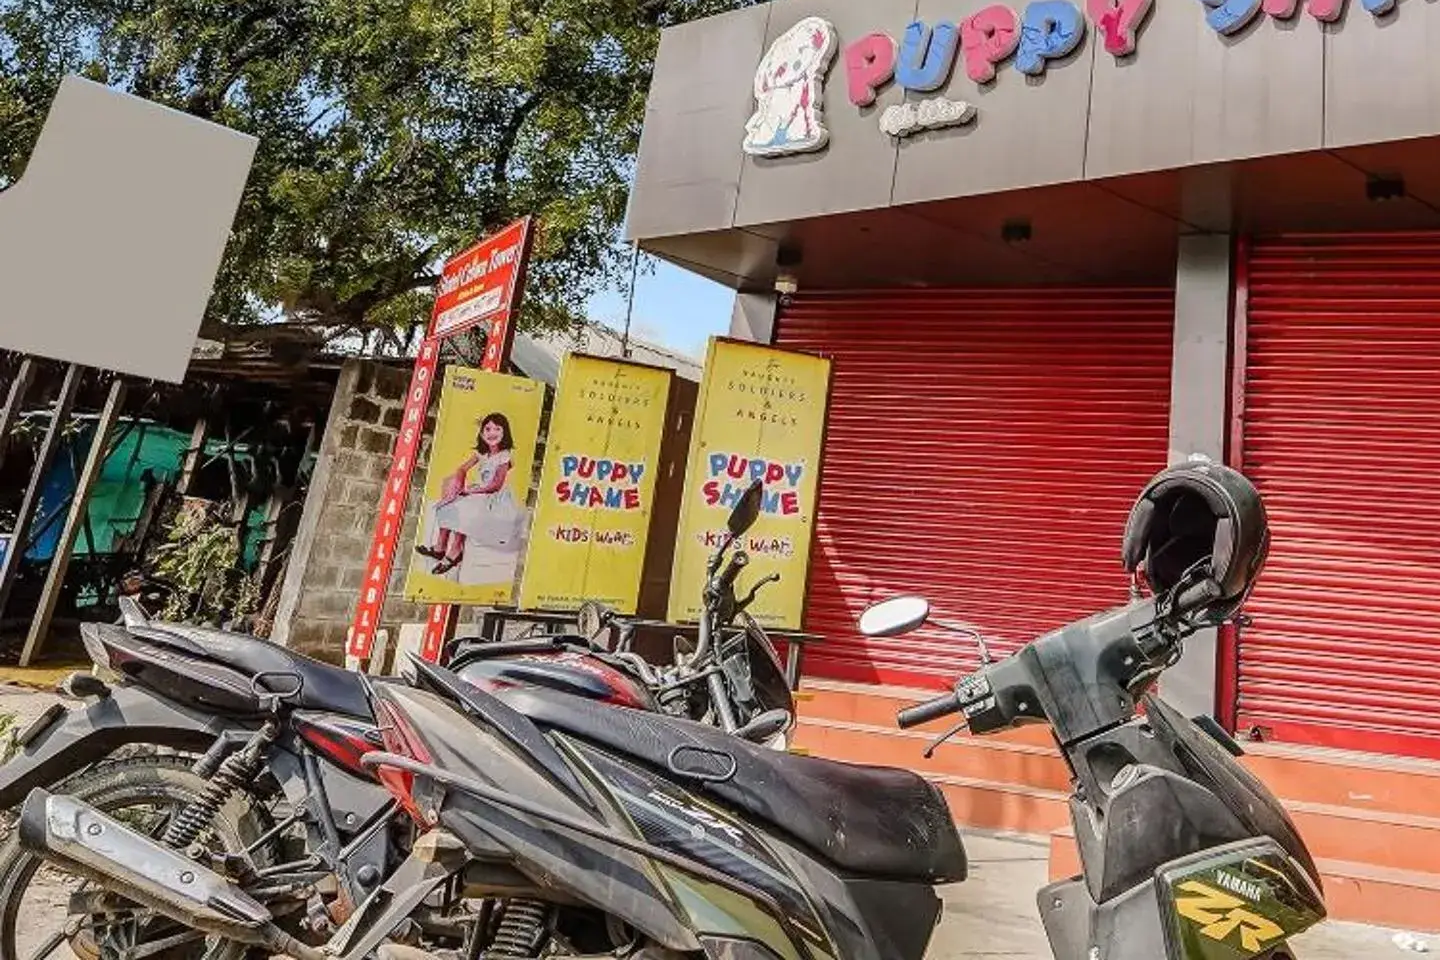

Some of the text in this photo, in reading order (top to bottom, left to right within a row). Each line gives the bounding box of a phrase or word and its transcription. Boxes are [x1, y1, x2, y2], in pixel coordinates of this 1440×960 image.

[562, 456, 644, 484] PUPPY
[709, 453, 802, 486] PUPPY
[356, 346, 433, 650] ROOMS AVAILABLE
[556, 481, 640, 509] SHAME
[703, 481, 799, 515] SHME
[556, 525, 588, 542] KIDS
[1216, 869, 1261, 901] YAMAHA
[1175, 880, 1285, 952] ZR
